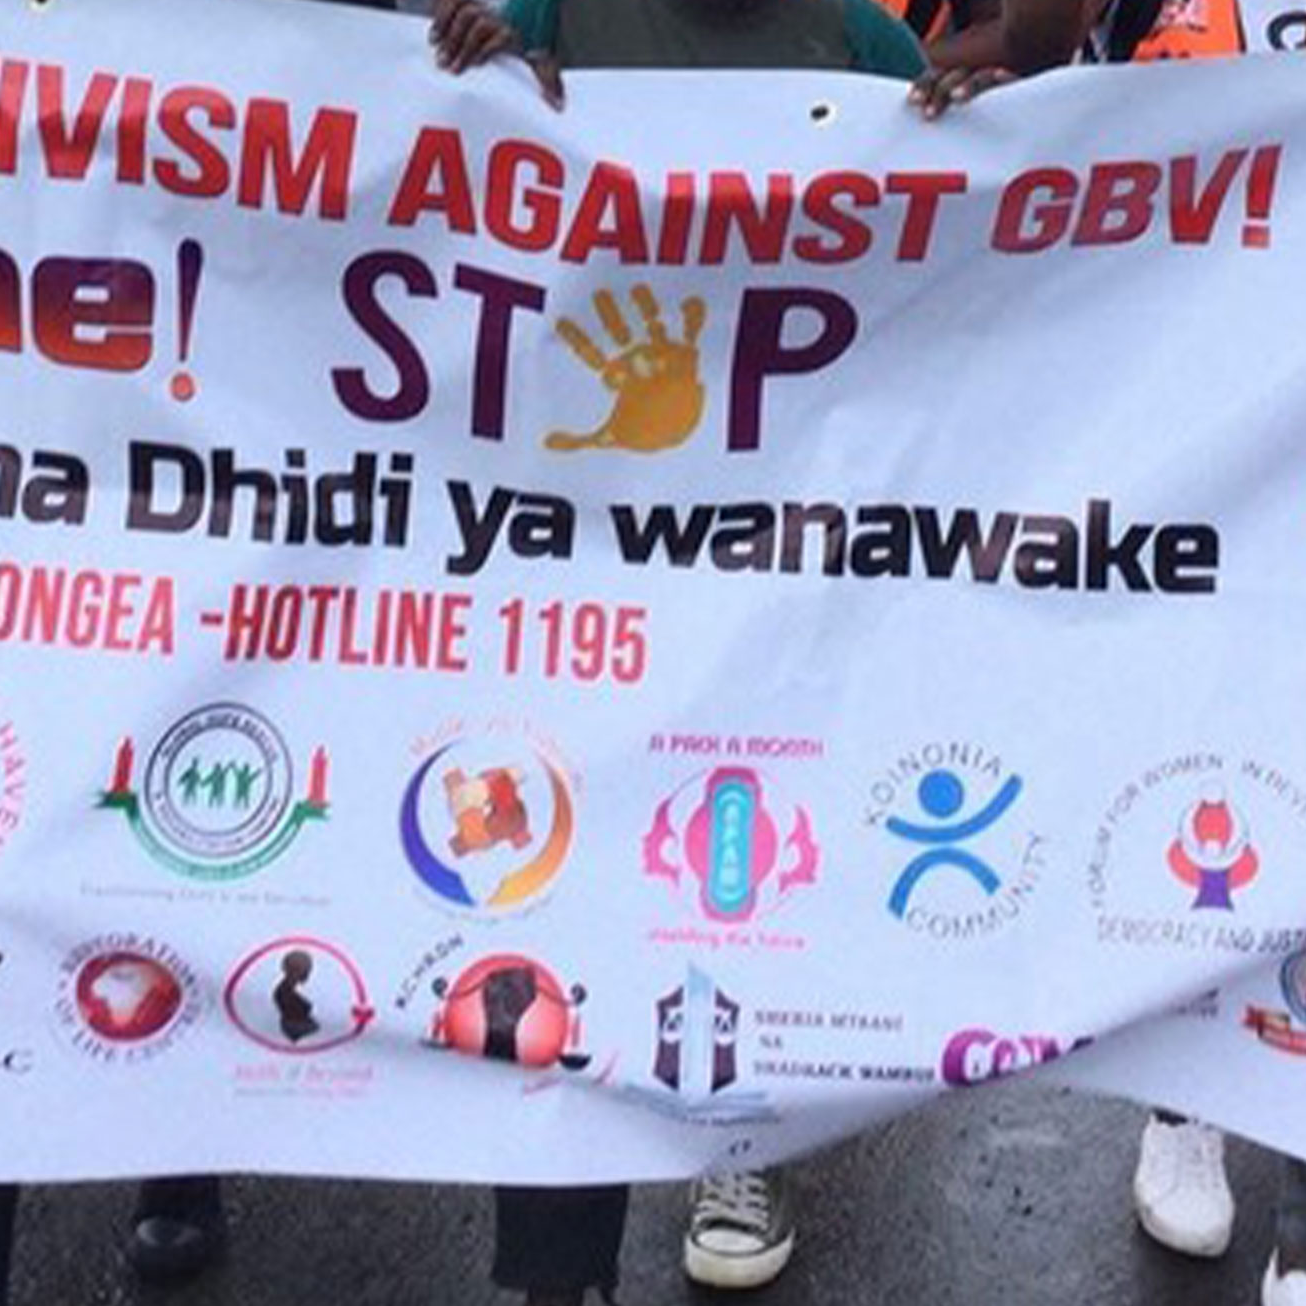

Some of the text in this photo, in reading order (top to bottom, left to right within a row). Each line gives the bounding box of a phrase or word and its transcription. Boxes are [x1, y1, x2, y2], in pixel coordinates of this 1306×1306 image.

[387, 126, 968, 268] AGAINST
[988, 143, 1283, 256] GBV!
[124, 439, 413, 548] Dhidi
[445, 478, 578, 577] ya
[610, 498, 1220, 594] wanawake
[498, 598, 649, 684] 1195
[1142, 754, 1224, 788] WOMEN
